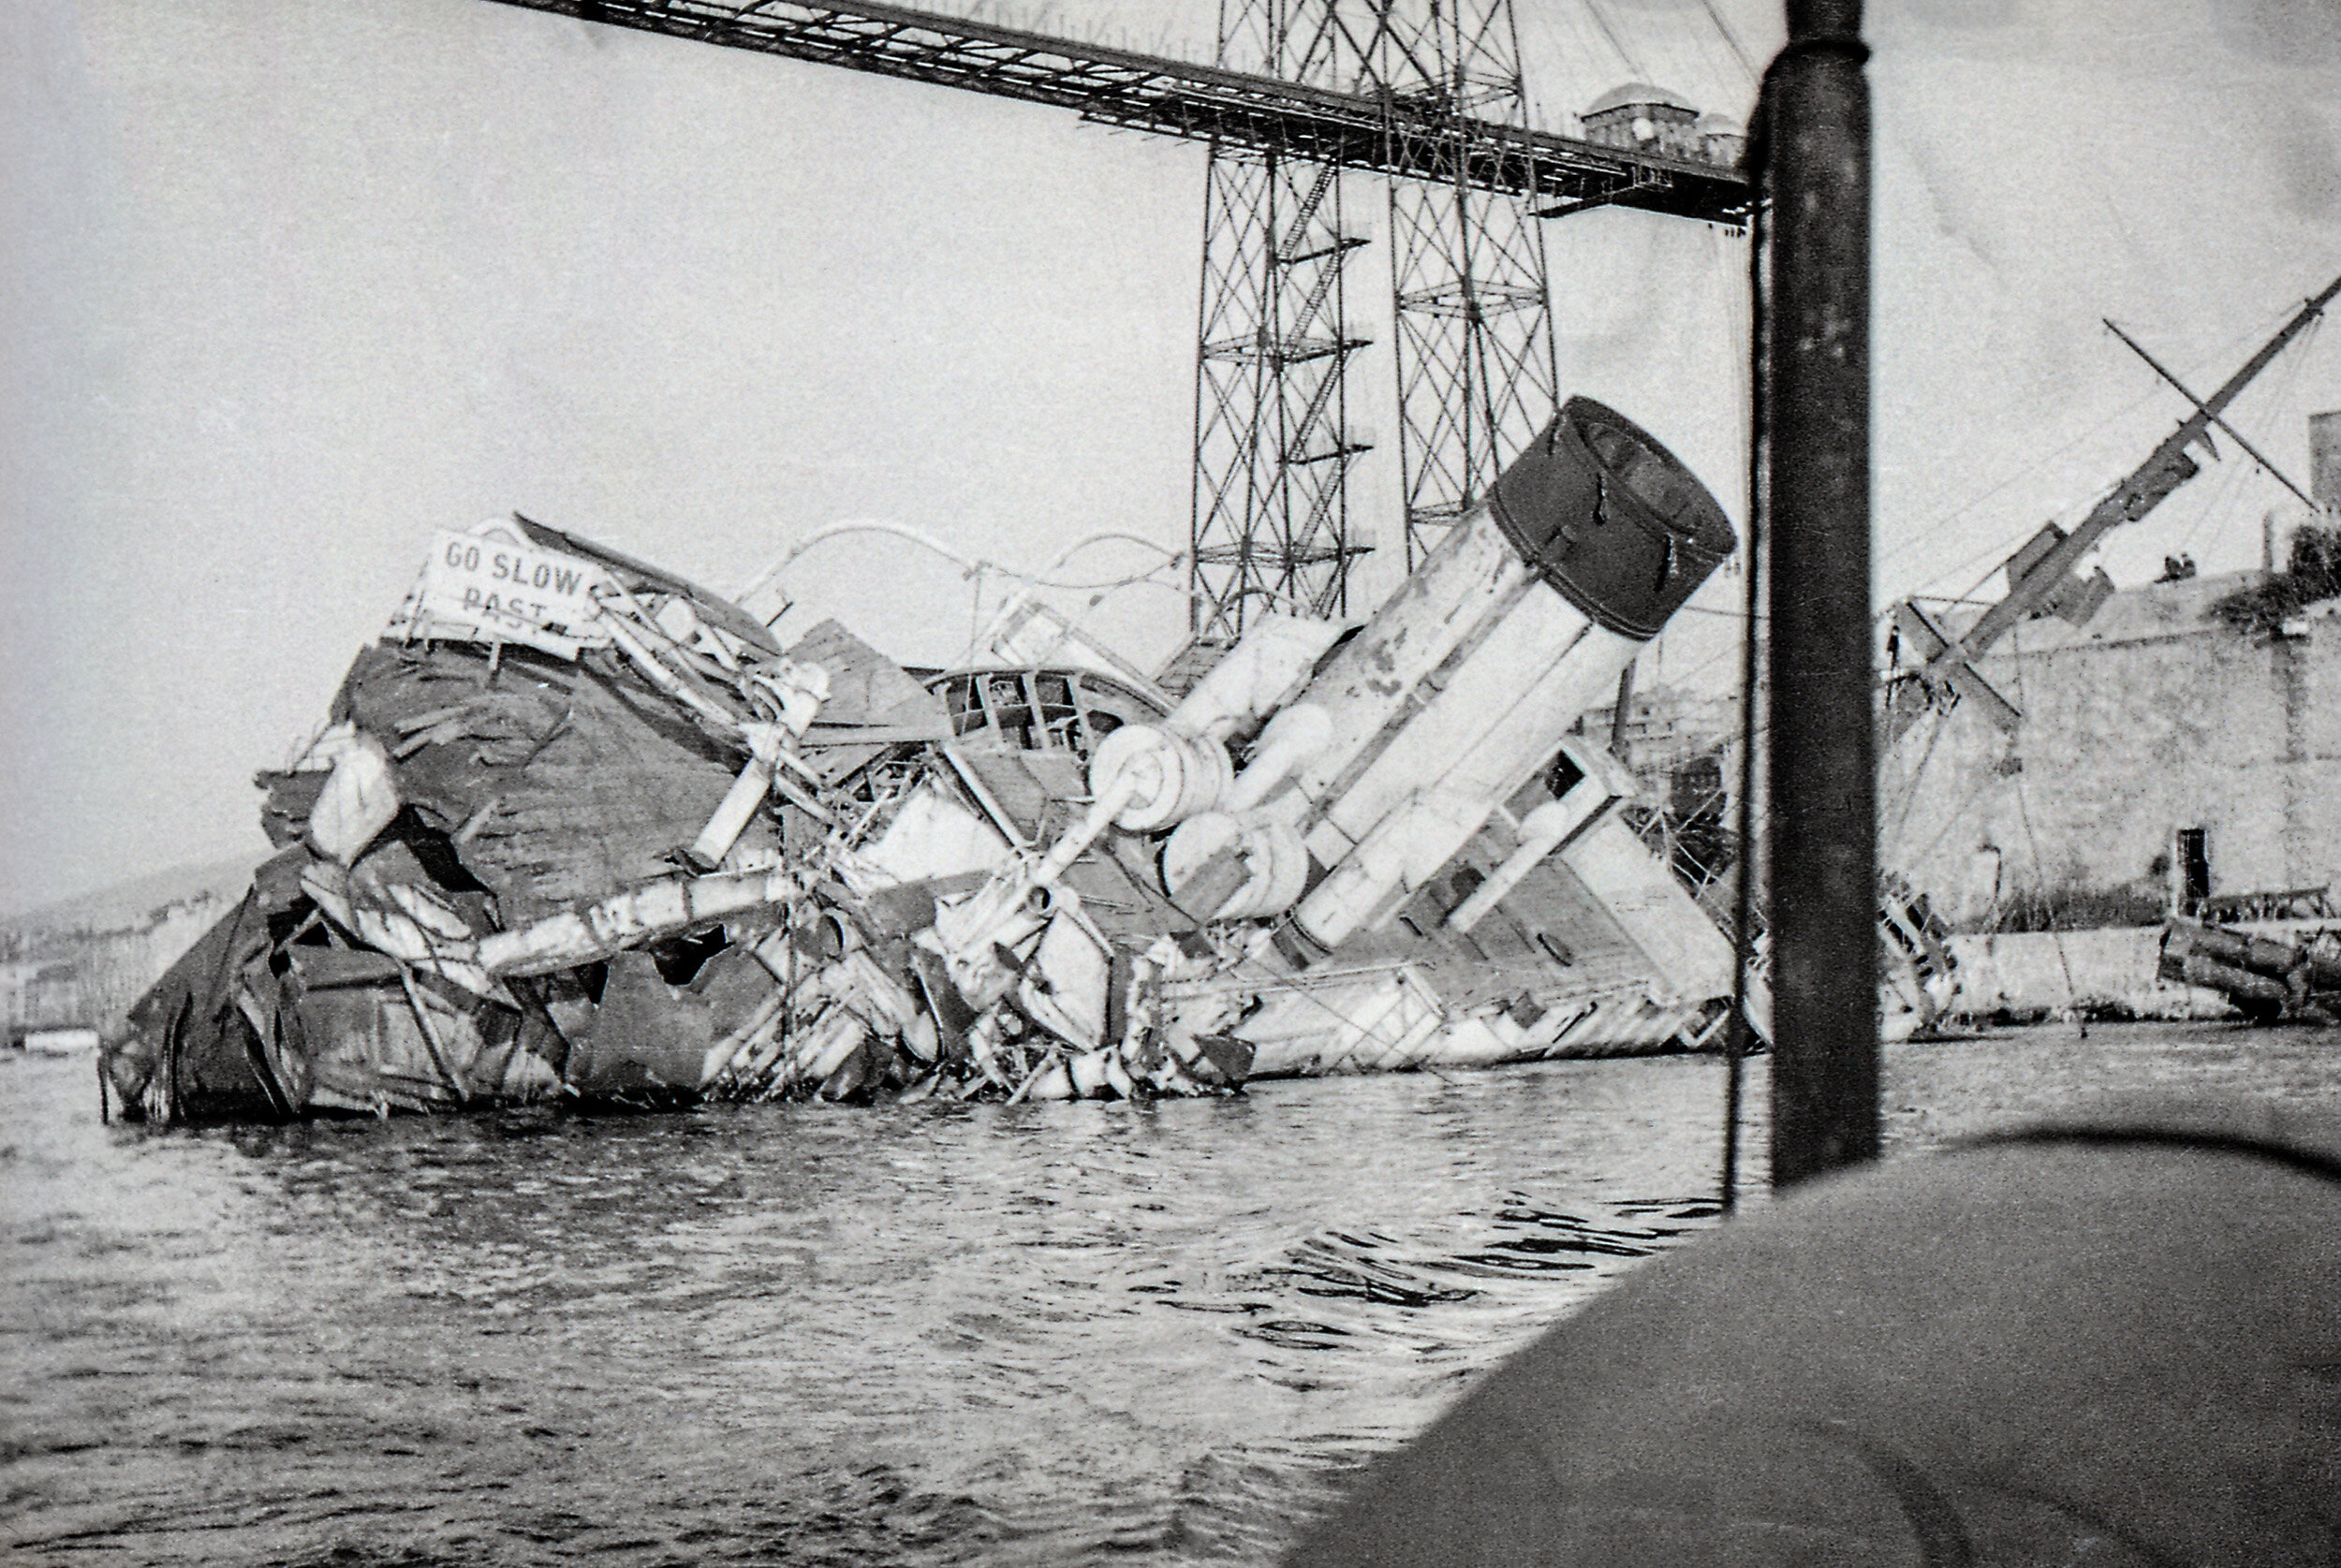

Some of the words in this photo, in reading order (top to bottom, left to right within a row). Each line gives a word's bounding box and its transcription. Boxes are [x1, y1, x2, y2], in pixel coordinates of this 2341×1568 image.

[446, 541, 480, 572] GO
[492, 552, 582, 596] SLOW
[463, 587, 547, 635] PAST
